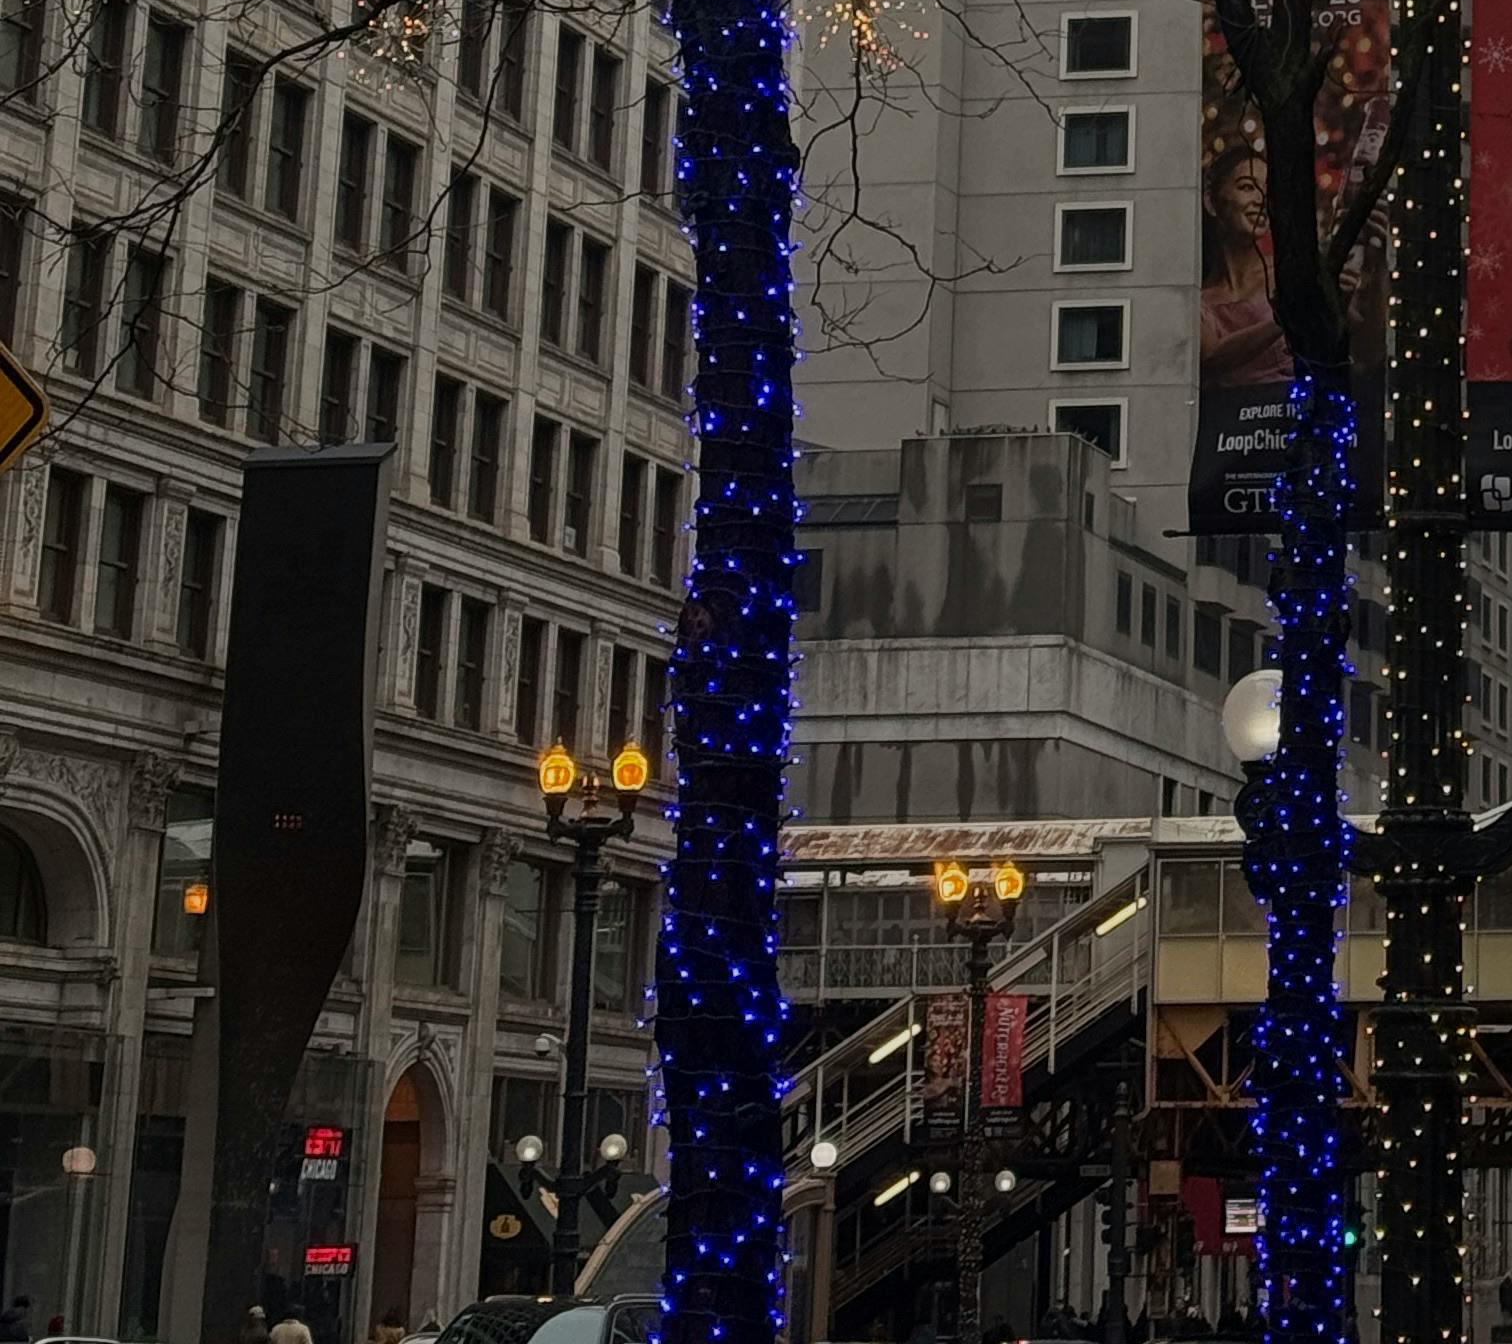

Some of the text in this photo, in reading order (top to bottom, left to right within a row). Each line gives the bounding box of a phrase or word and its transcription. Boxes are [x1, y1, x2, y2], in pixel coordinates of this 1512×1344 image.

[1239, 403, 1284, 421] EXPLORE
[302, 1158, 337, 1180] CHICAGO
[304, 1263, 349, 1275] CHICAGO
